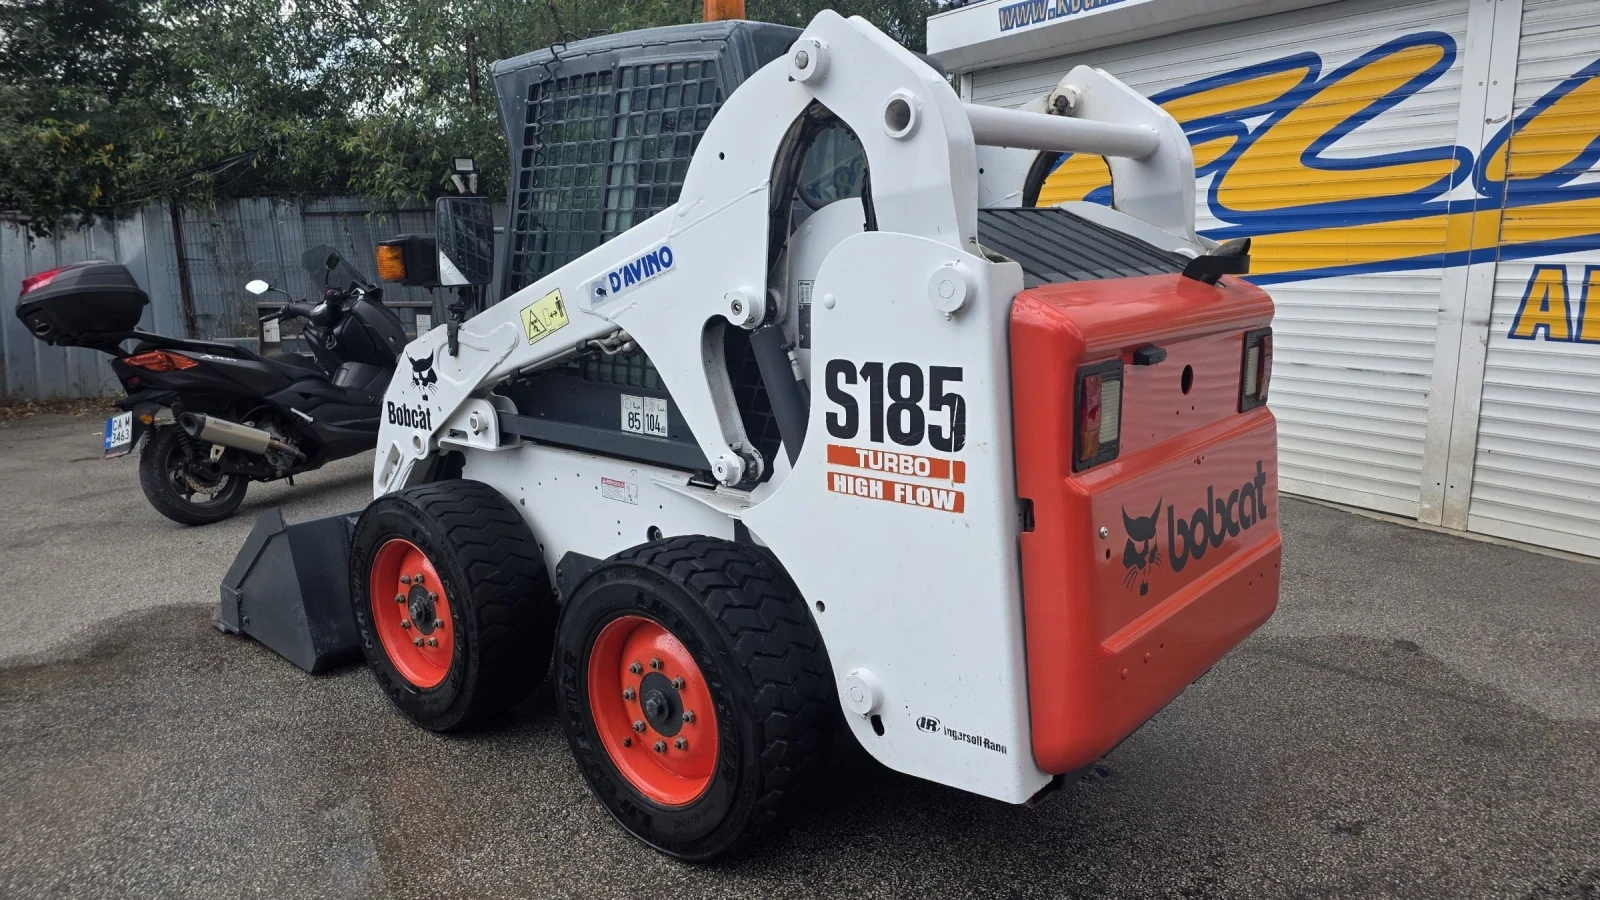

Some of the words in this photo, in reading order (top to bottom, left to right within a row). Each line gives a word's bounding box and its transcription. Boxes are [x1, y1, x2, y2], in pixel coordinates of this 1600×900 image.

[608, 246, 673, 293] D'AVINO
[387, 401, 432, 431] Bobcat
[825, 359, 966, 452] S185
[628, 411, 641, 430] 85
[646, 413, 660, 432] 104
[112, 429, 129, 444] 3463
[856, 449, 930, 477] TURBO
[833, 474, 883, 499] HIGH
[894, 483, 956, 511] FLOW
[1167, 460, 1267, 572] bobcat
[919, 716, 938, 732] IR
